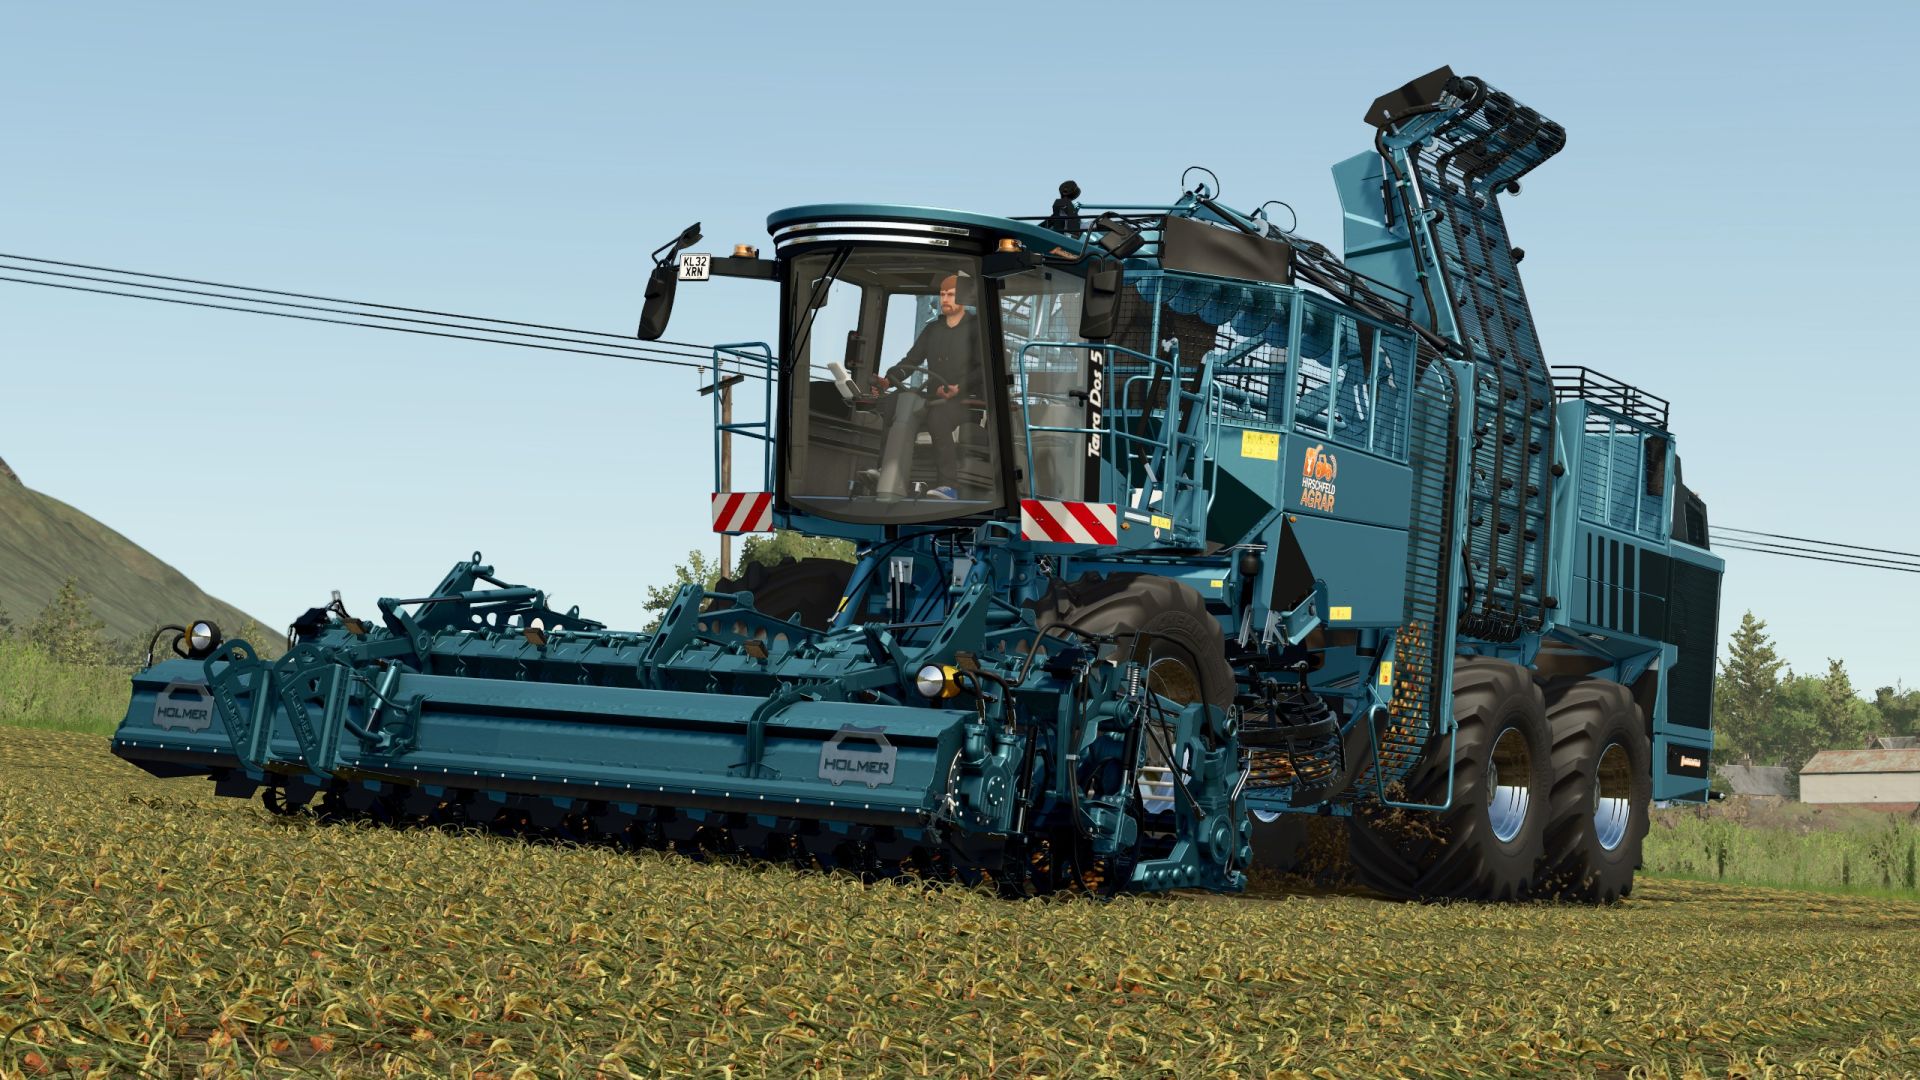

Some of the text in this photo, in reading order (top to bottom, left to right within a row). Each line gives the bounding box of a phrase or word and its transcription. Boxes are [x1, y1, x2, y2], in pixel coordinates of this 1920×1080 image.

[683, 256, 707, 267] KL32
[685, 266, 703, 277] XRN
[1090, 349, 1103, 366] 5
[1089, 369, 1103, 408] Dos
[1301, 477, 1336, 495] HIRSCHFELD
[1299, 487, 1336, 513] AGRAR
[157, 706, 208, 721] HOLMER
[823, 758, 890, 775] HOLMER
